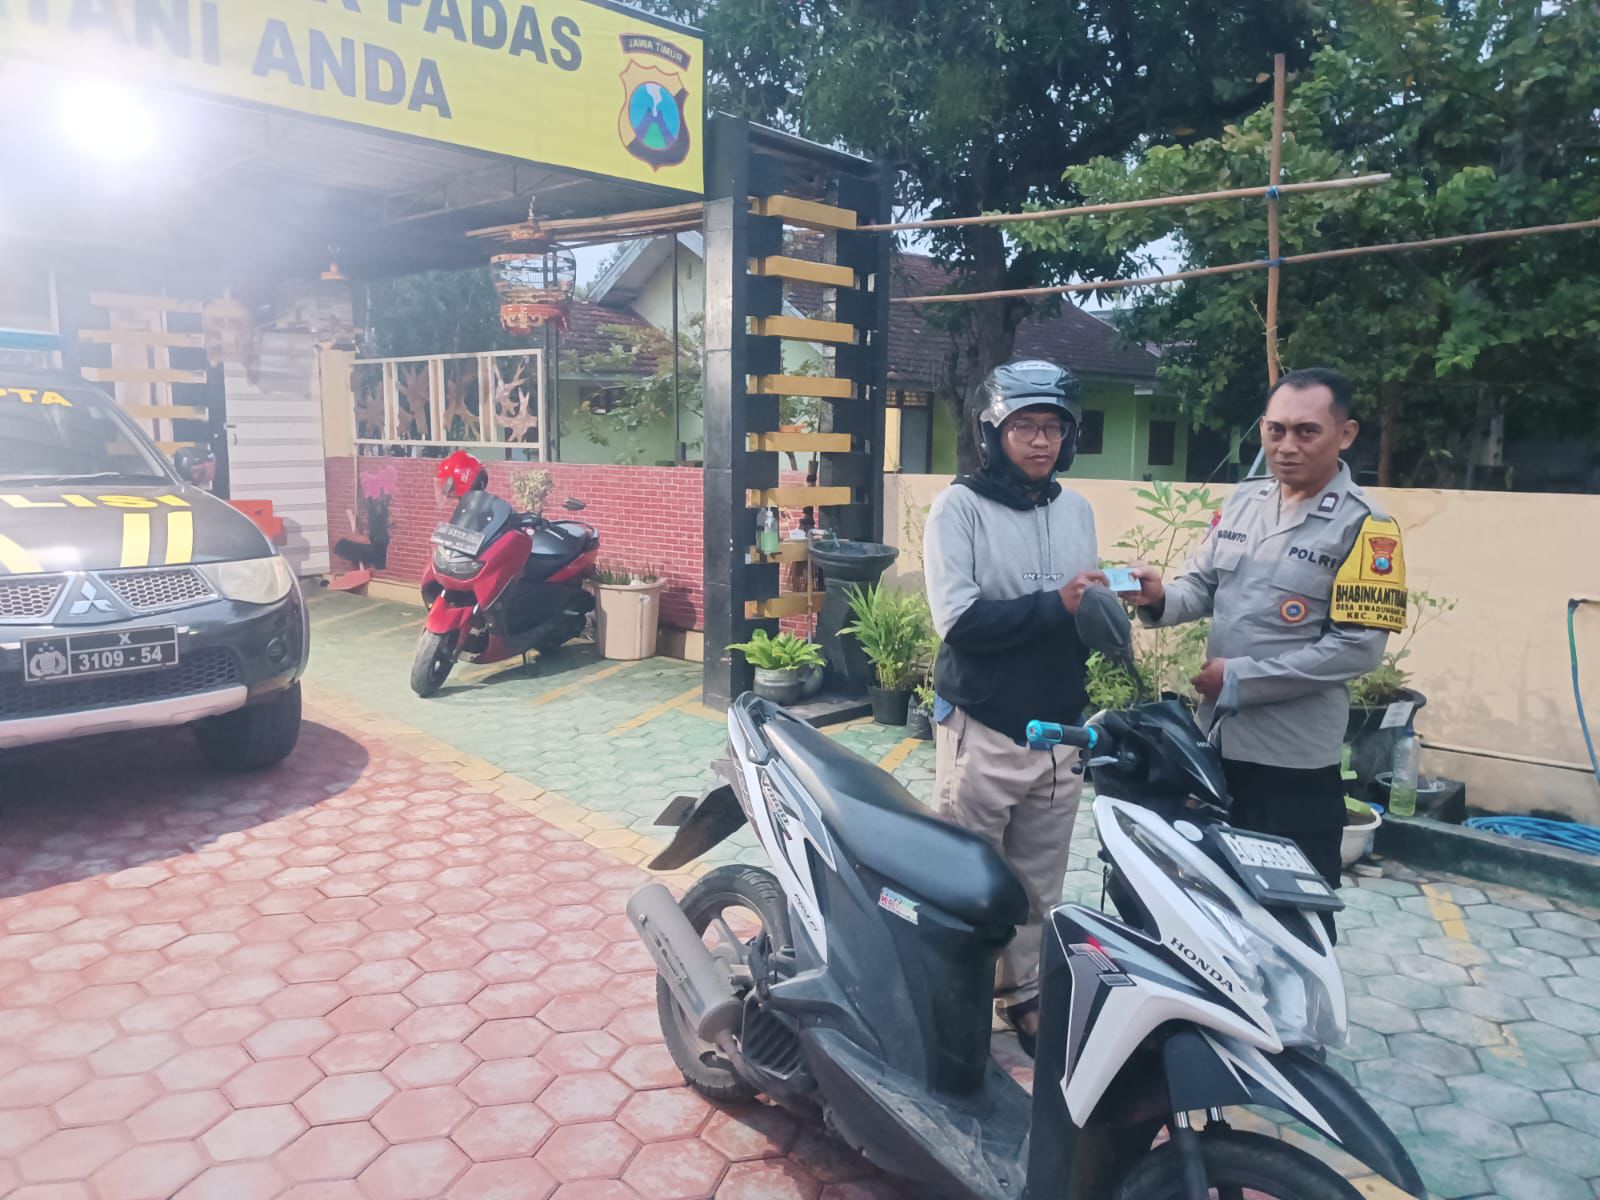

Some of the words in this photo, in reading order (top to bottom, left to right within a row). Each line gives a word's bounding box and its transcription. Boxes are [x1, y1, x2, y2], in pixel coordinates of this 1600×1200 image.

[628, 39, 653, 50] JAWA
[656, 42, 683, 63] TIMUR
[252, 17, 453, 120] ANDA
[1288, 546, 1337, 569] POLRI
[118, 632, 132, 646] X
[78, 650, 125, 671] 3109
[141, 645, 163, 664] 54
[1170, 937, 1233, 993] HONDA
